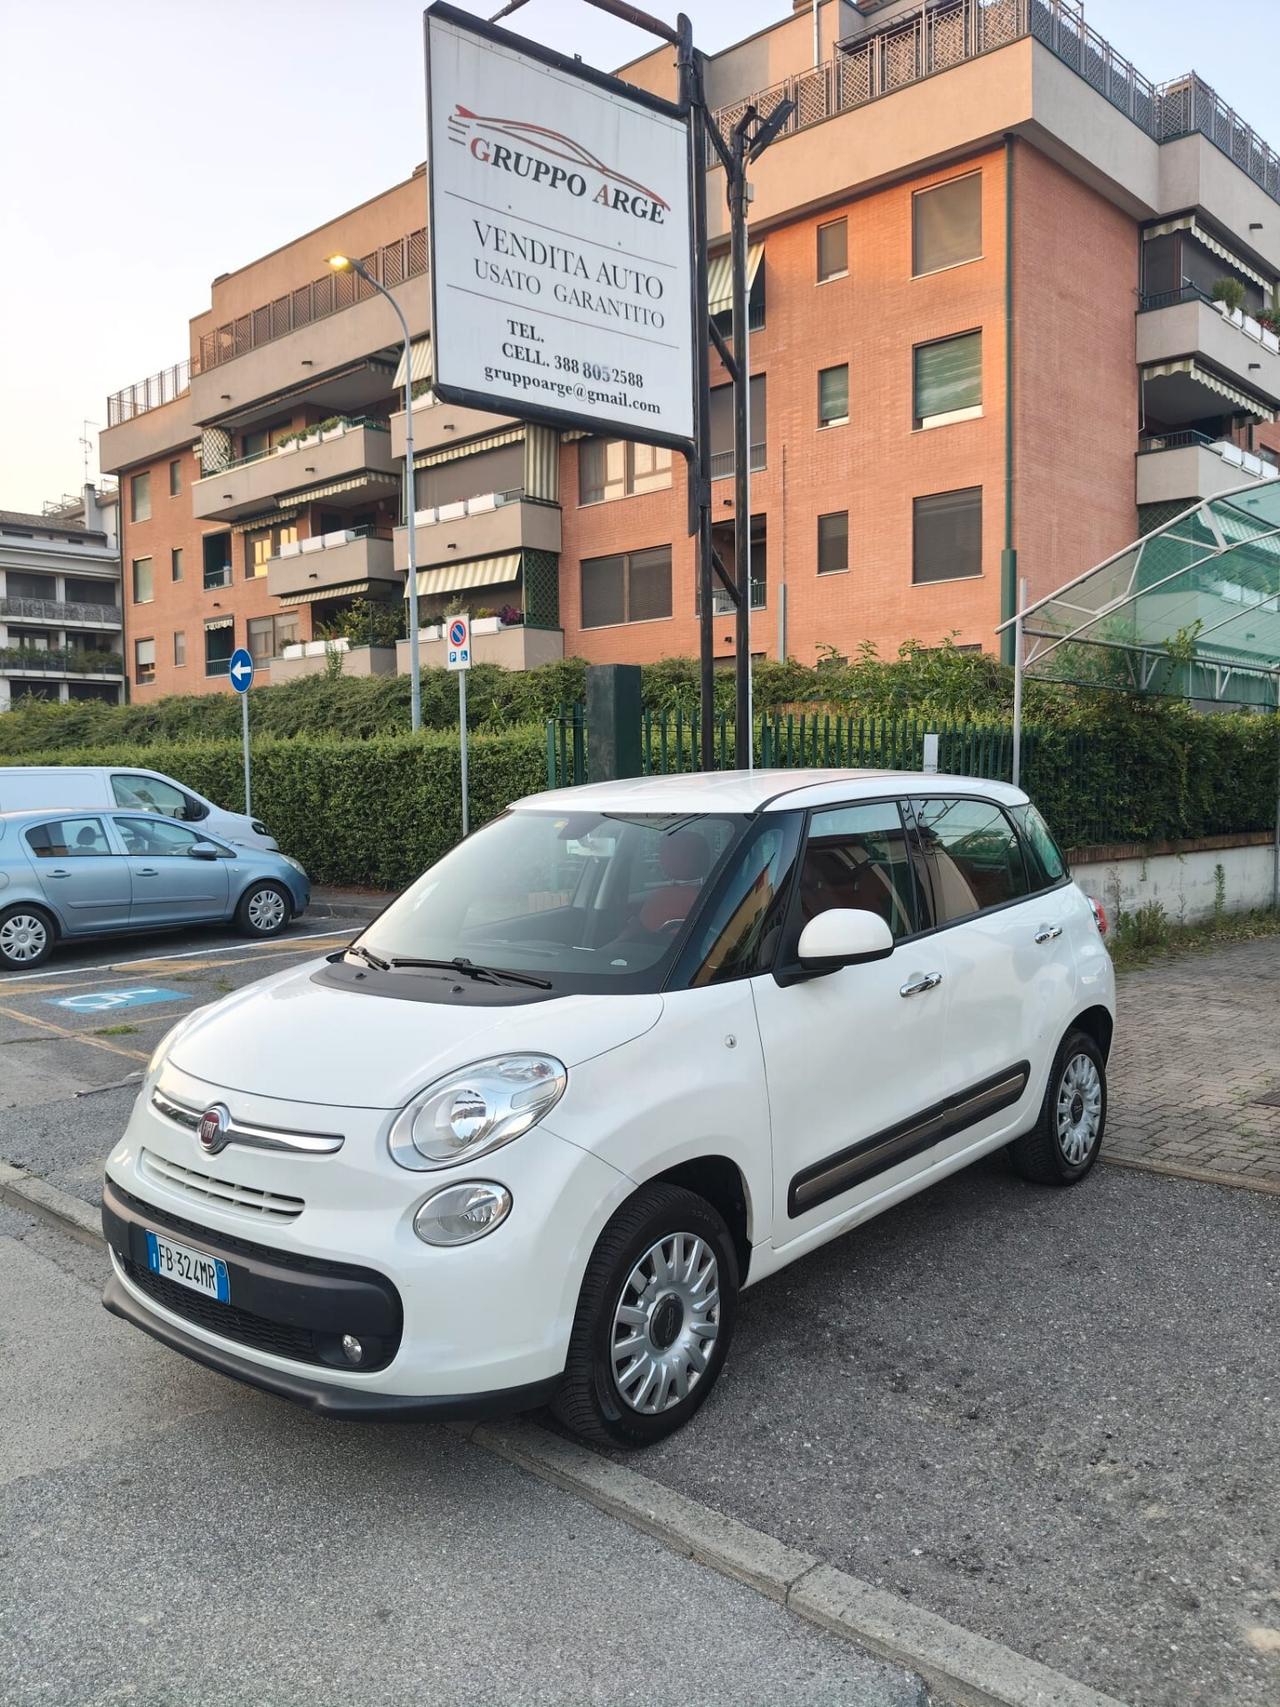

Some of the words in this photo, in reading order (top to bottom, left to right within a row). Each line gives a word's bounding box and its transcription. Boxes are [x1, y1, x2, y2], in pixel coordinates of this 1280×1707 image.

[470, 137, 587, 197] GRUPPO
[592, 184, 665, 225] ARGE
[472, 219, 590, 280] VENDITA
[596, 261, 664, 300] AUTO
[474, 258, 541, 295] USATO
[553, 283, 665, 329] GARANTITO
[502, 342, 550, 367] CELL.
[507, 319, 545, 343] TEL.
[484, 366, 661, 414] gruppoarge@gmail.com
